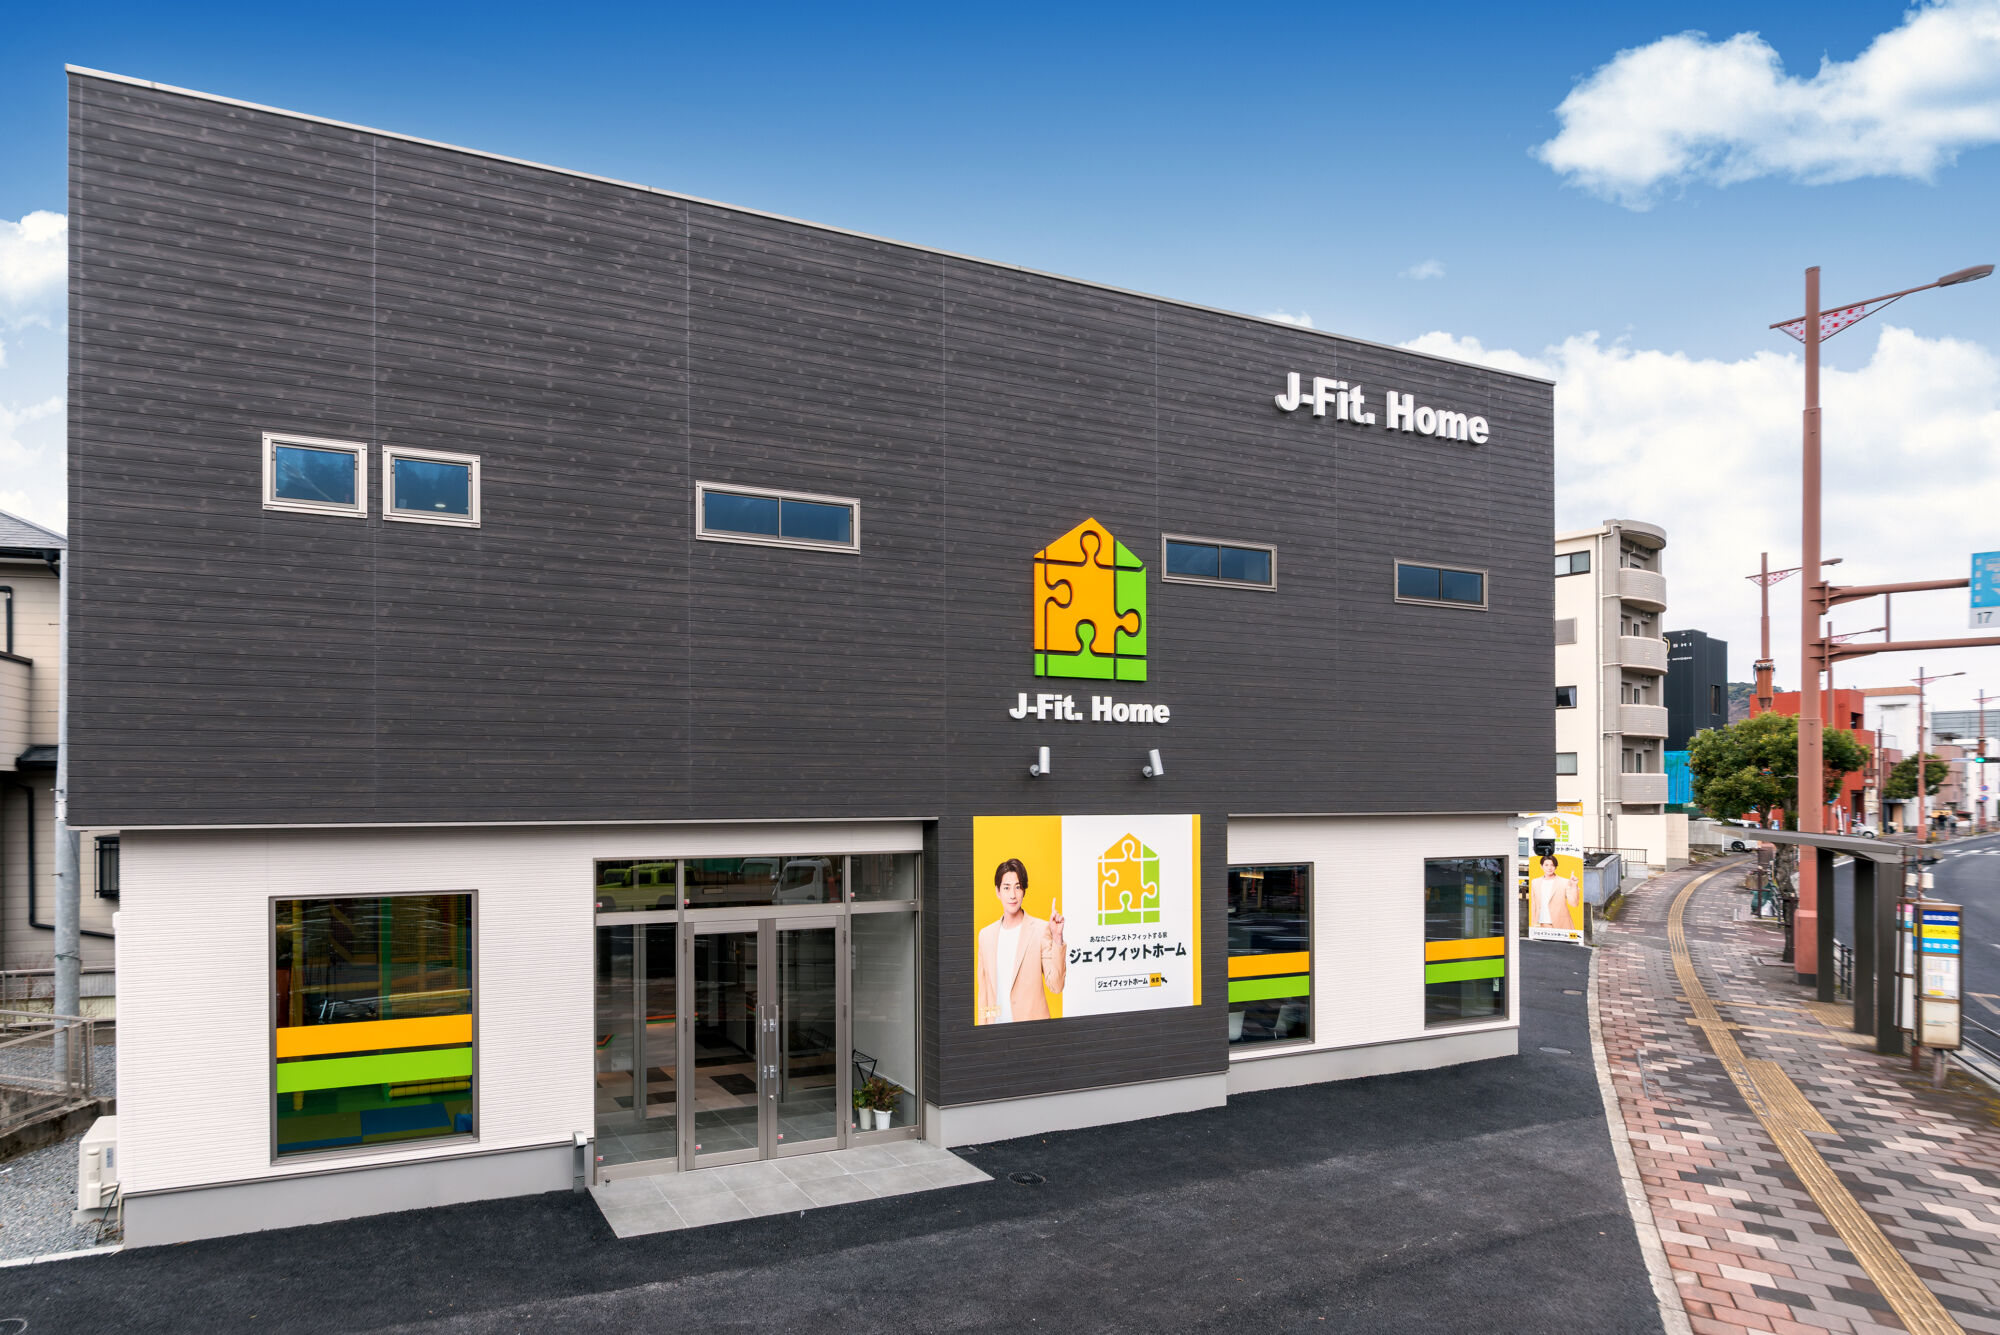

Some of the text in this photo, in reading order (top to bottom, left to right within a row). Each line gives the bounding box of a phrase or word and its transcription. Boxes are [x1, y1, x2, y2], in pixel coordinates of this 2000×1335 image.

[1275, 372, 1489, 444] J-Fit. Home
[1009, 692, 1170, 724] J-Fit. Home
[1069, 942, 1187, 965] ジェイフィットホーム
[1097, 977, 1148, 988] ジェイフィットホーム
